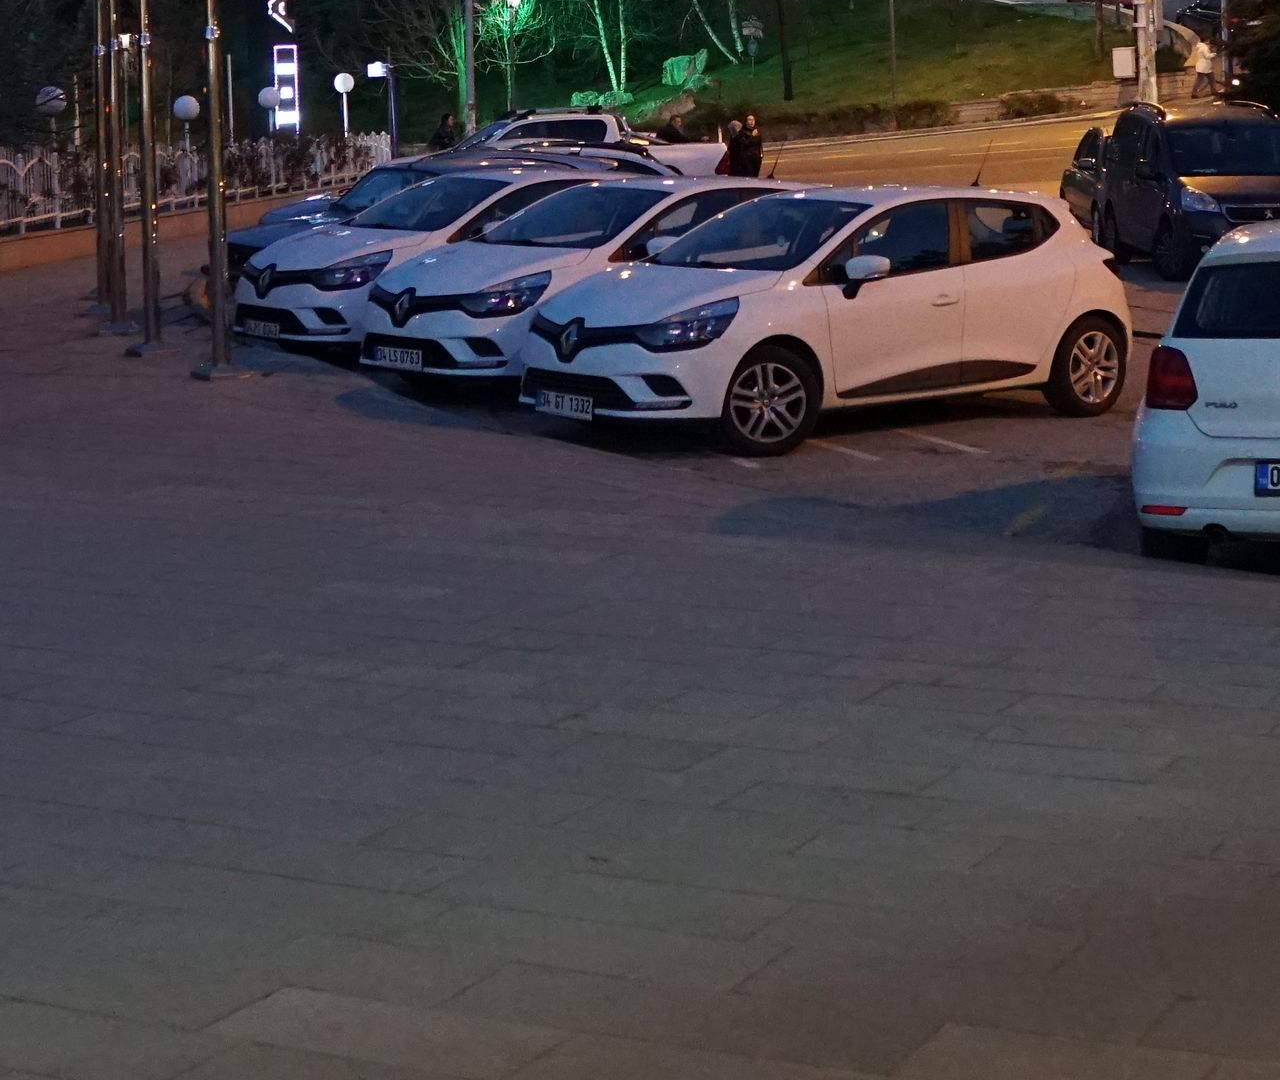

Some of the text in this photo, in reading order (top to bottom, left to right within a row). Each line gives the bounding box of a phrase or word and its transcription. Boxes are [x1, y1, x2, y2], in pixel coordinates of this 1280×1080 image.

[377, 347, 420, 365] 34 LS 0763
[542, 392, 591, 414] 34 GT 1332
